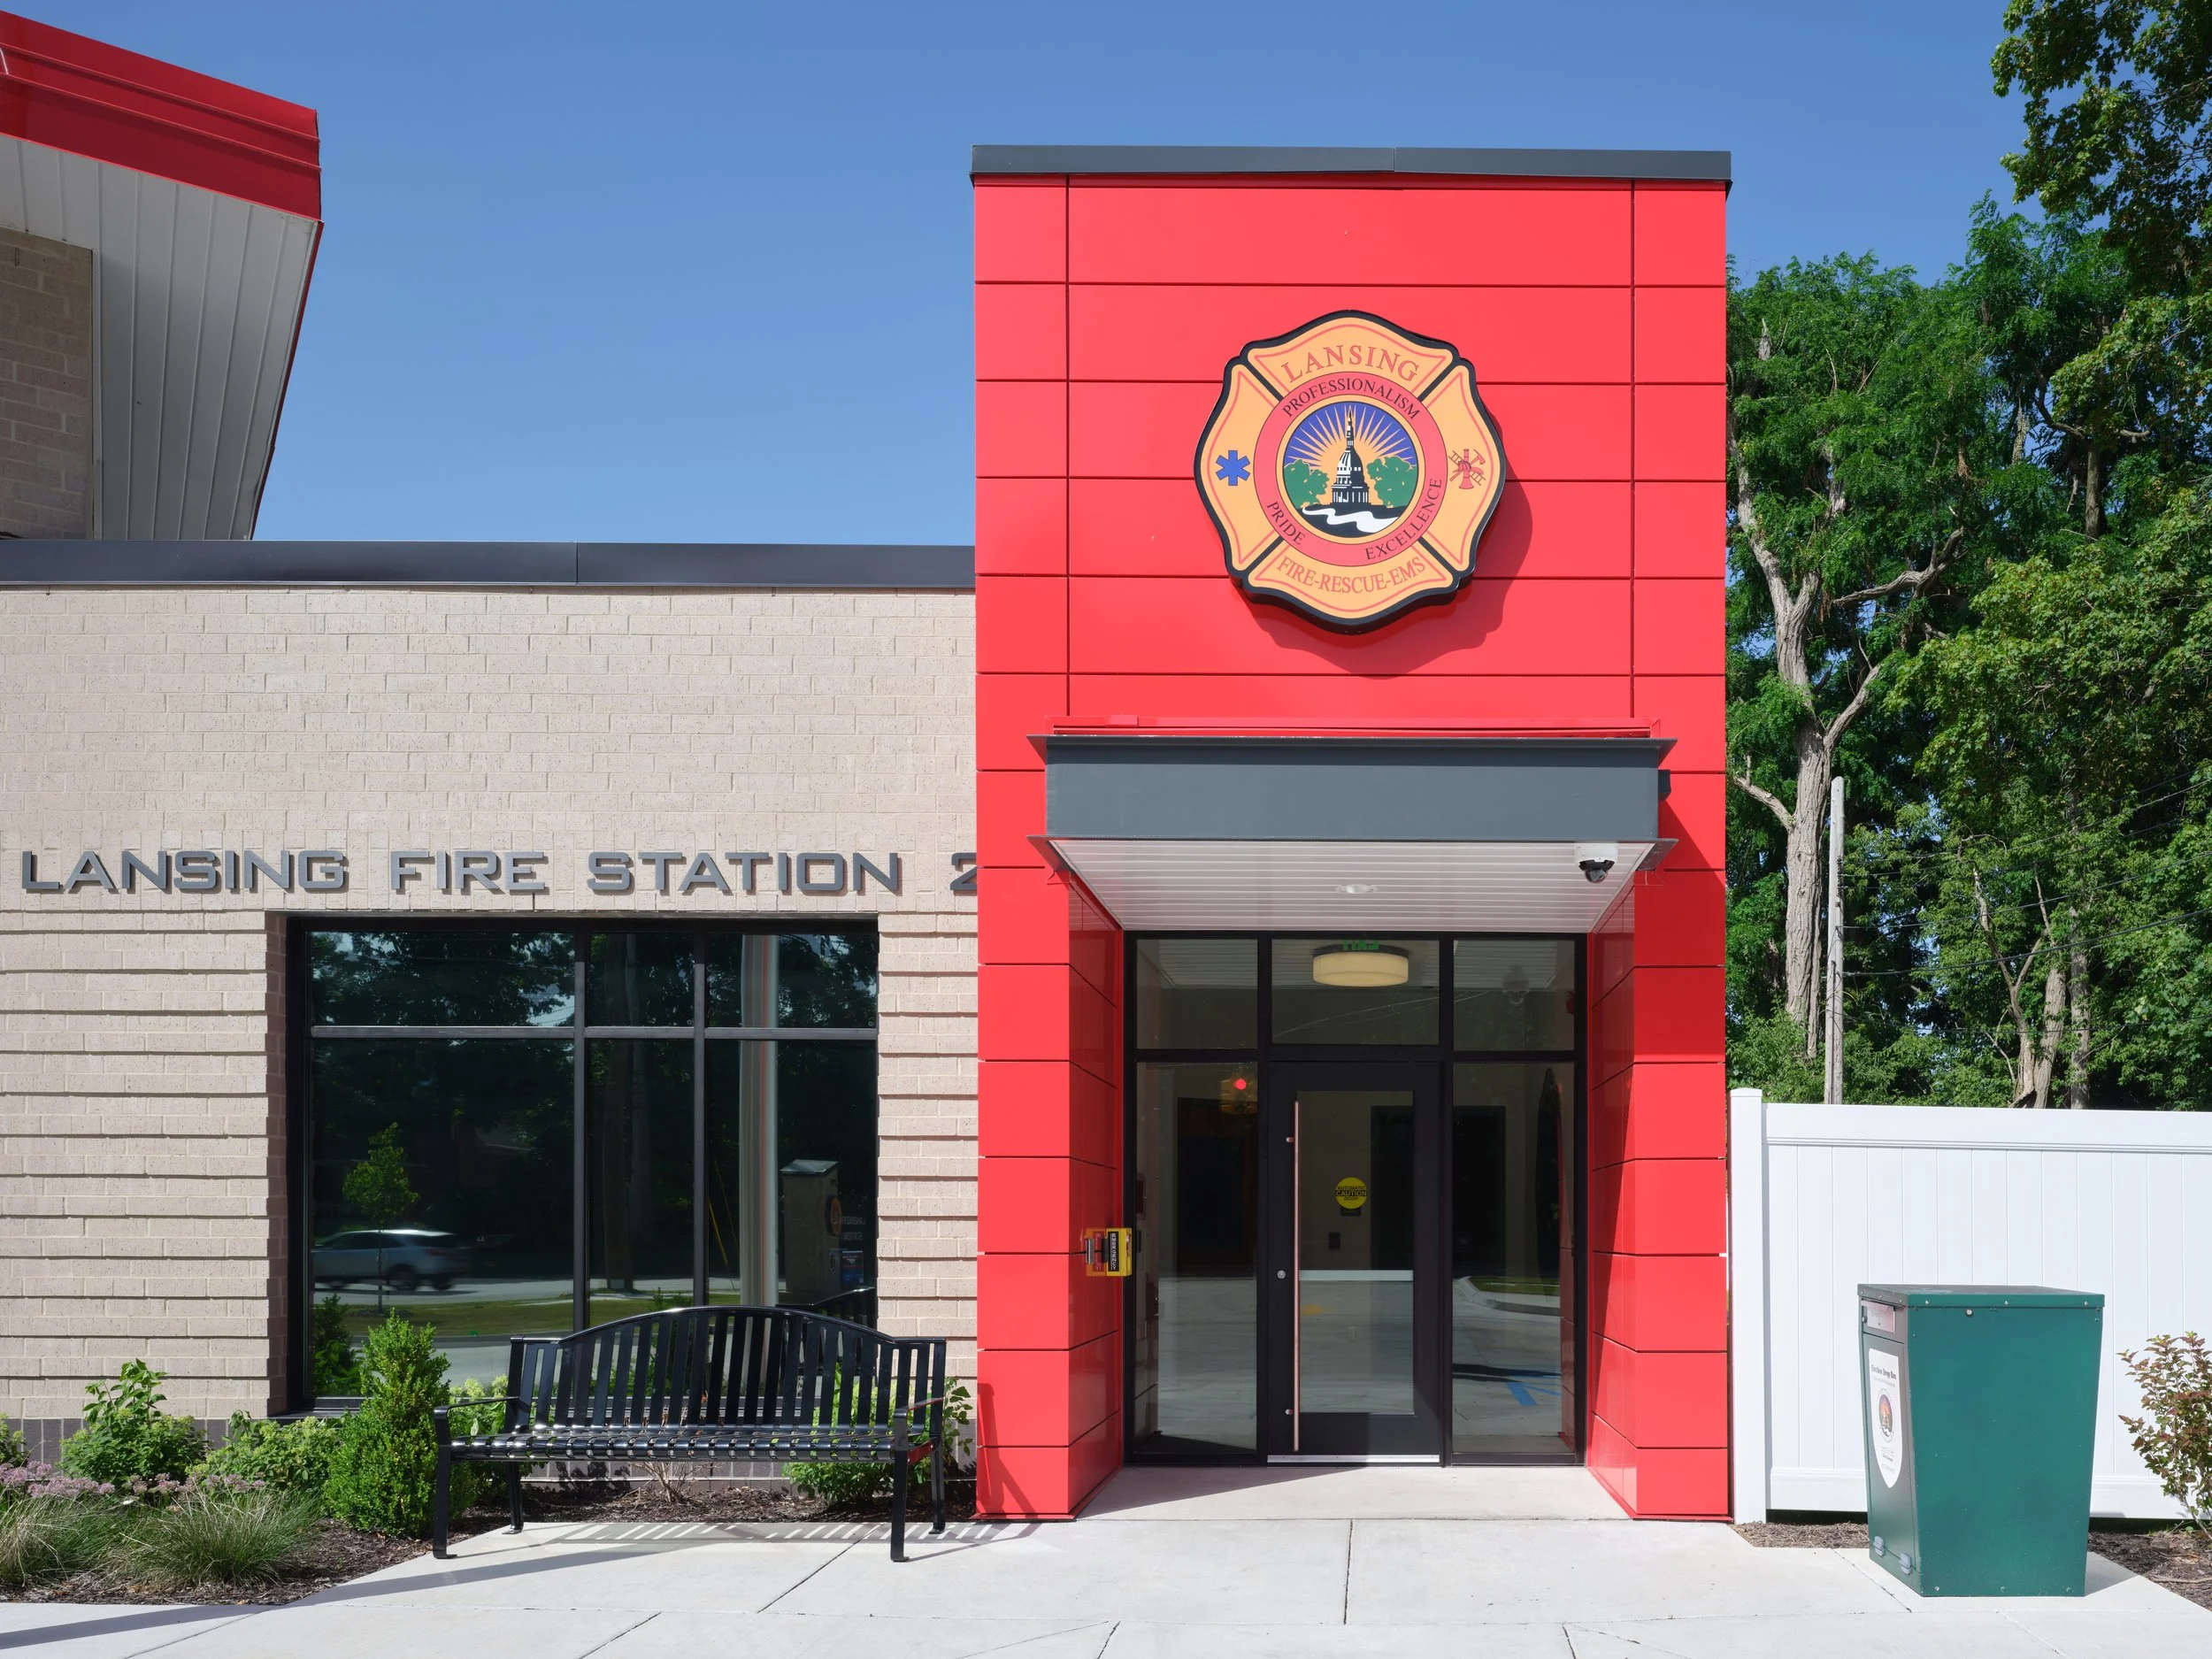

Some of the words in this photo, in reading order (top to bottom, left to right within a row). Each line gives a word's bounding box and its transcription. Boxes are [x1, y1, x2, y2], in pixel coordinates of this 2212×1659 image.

[1280, 345, 1420, 383] LANSING
[1282, 378, 1421, 420] PROFESSIONALISM
[1267, 501, 1306, 545] PRIDE
[1365, 478, 1442, 561] EXCELLENCE
[1277, 557, 1425, 594] FIRE-RESCUE-EMS
[22, 850, 348, 893] LANSING
[390, 850, 547, 894] FIRE
[588, 852, 902, 895] STATION
[949, 852, 978, 892] 2
